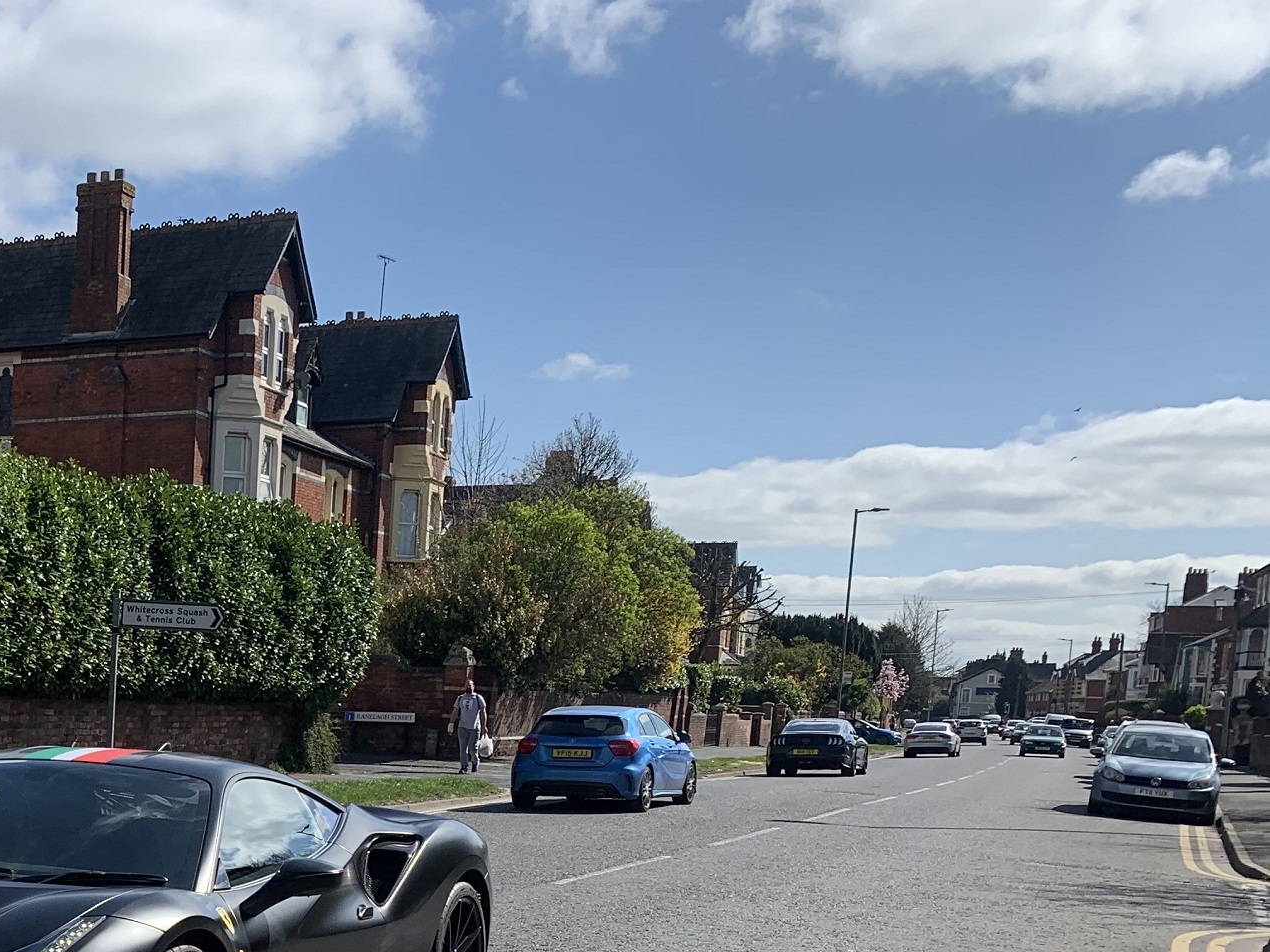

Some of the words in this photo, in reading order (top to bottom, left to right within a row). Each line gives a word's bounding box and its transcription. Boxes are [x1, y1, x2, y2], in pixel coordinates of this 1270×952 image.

[127, 605, 174, 614] Whitecross
[177, 608, 208, 616] Squash
[146, 615, 173, 623] Tennis
[175, 617, 196, 625] Club
